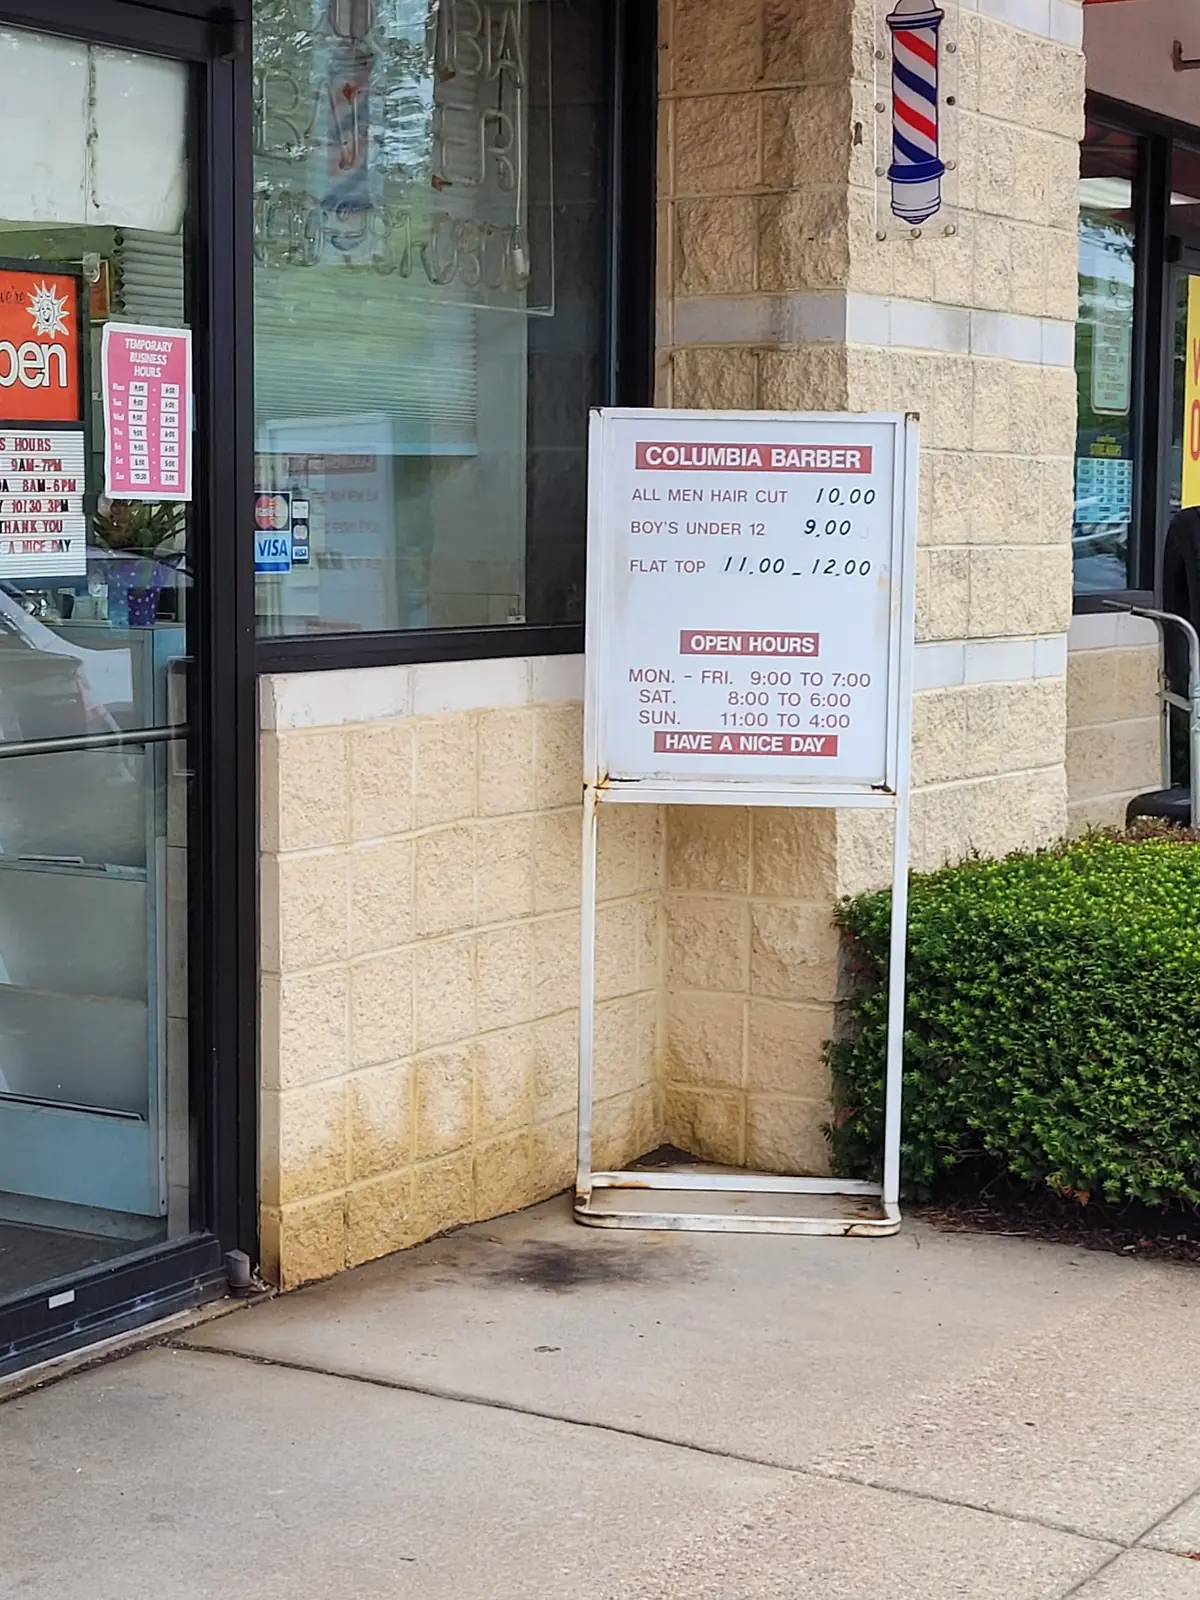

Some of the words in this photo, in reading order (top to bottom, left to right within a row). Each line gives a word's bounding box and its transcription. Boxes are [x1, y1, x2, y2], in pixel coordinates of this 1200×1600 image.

[124, 338, 173, 352] TEMPORARY
[129, 352, 167, 365] BUSINESS
[134, 365, 161, 378] HOURS
[15, 438, 51, 451] HOURS
[11, 459, 62, 472] 9AM-7PM
[645, 446, 762, 467] COLUMBIA
[771, 448, 861, 469] BARBER
[22, 479, 76, 492] 8AM-6PM
[631, 489, 661, 501] ALL
[668, 489, 703, 502] MEN
[711, 490, 748, 503] HAIR
[755, 490, 788, 504] CUT
[815, 487, 876, 506] 10.00
[48, 500, 69, 513] 3PM
[43, 520, 63, 533] YOU
[630, 521, 679, 534] BOY'S
[686, 522, 741, 535] UNDER
[749, 523, 765, 536] 12
[803, 519, 851, 538] 9.00
[8, 541, 15, 554] A
[22, 540, 46, 553] NICE
[51, 539, 71, 553] DAY
[258, 539, 288, 556] VISA
[629, 559, 667, 573] FLAT
[675, 560, 706, 573] TOP
[724, 556, 785, 575] 11.00
[811, 558, 871, 577] 12.00
[690, 635, 742, 652] OPEN
[749, 636, 815, 654] HOURS
[628, 669, 675, 684] MON.
[701, 670, 733, 685] FRI.
[750, 671, 791, 686] 9:00
[800, 672, 823, 687] TO
[831, 673, 871, 688] 7:00
[639, 689, 676, 704] SAT.
[728, 692, 769, 706] 8:00
[778, 692, 801, 707] TO
[810, 693, 851, 707] 6:00
[638, 710, 681, 725] SUN.
[720, 713, 768, 727] 11:00
[777, 713, 800, 728] TO
[808, 714, 850, 729] 4:00
[665, 734, 713, 750] HAVE
[719, 735, 733, 751] A
[739, 736, 783, 752] NICE
[790, 737, 826, 753] DAY
